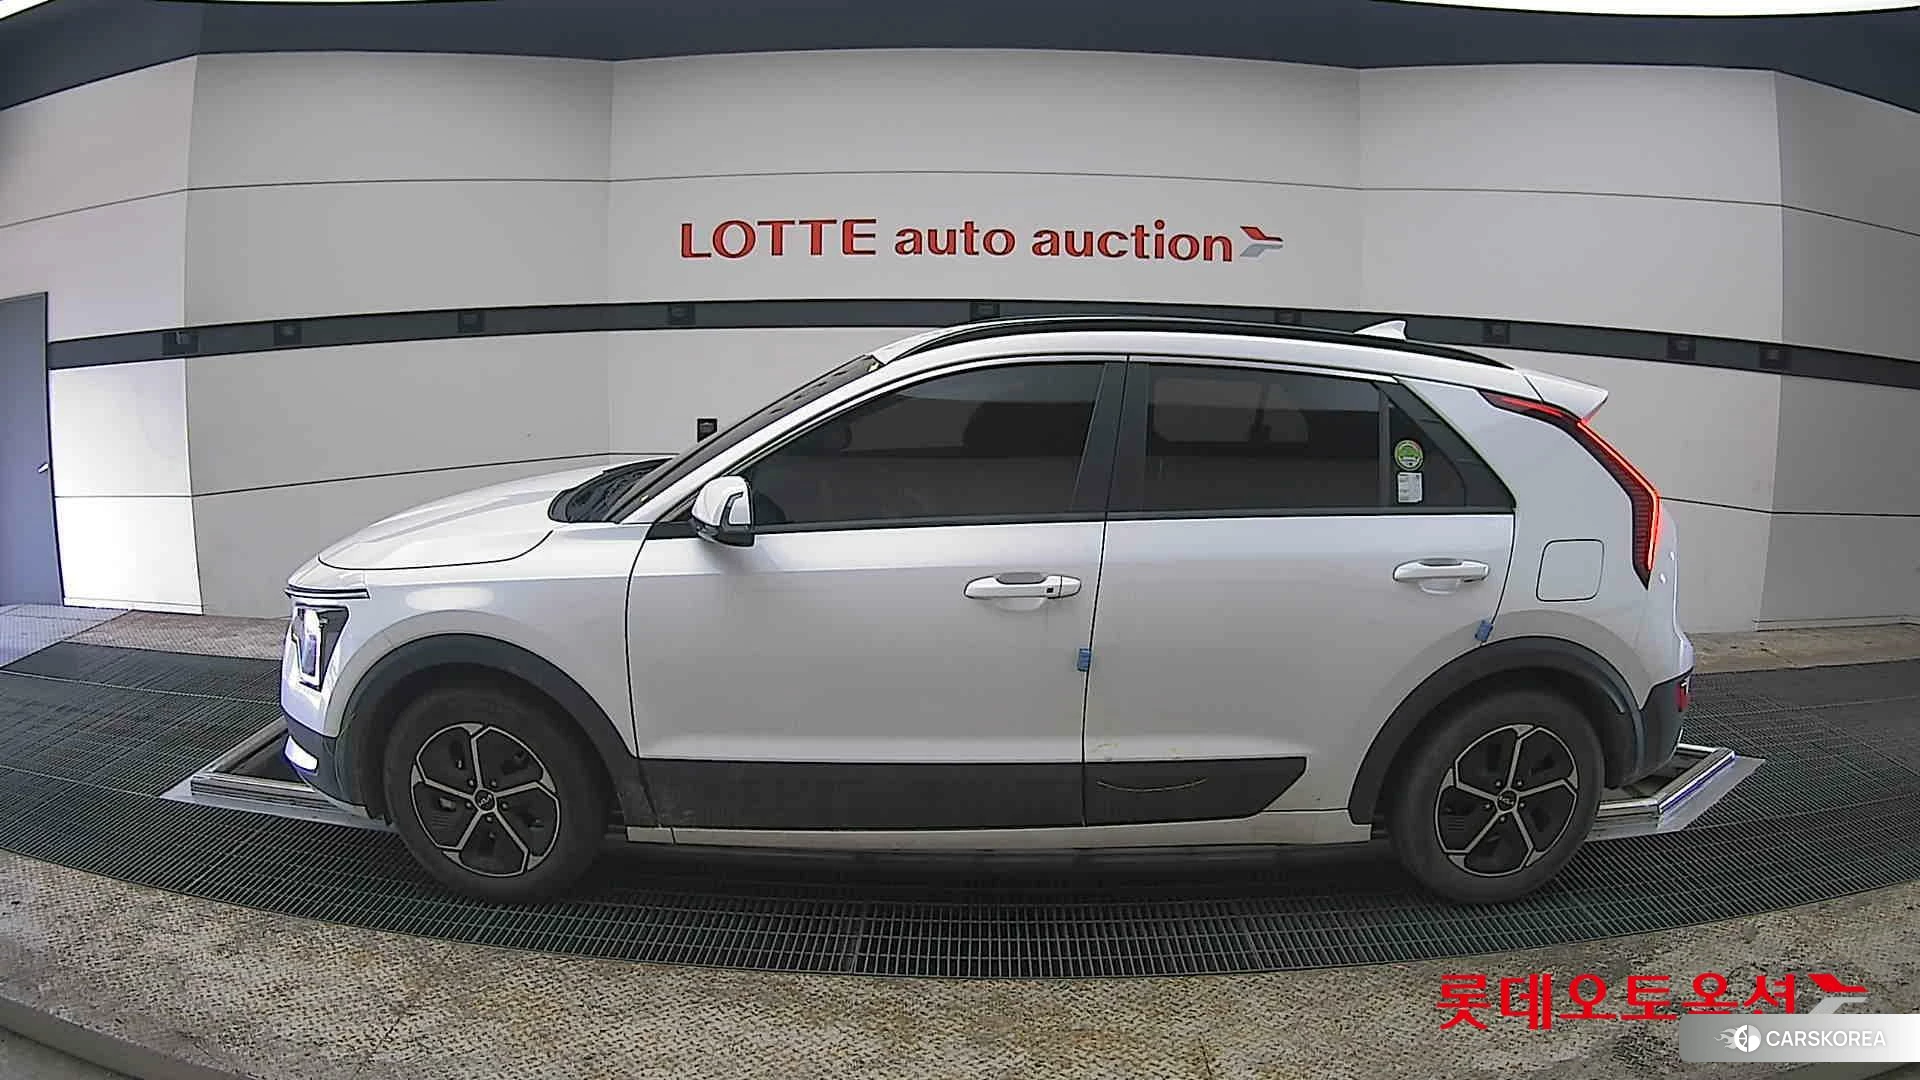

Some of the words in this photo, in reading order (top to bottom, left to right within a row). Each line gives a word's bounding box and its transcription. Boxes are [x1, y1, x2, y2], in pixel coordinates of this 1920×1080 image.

[680, 218, 877, 259] LOTTE
[894, 220, 1016, 256] auto
[1031, 219, 1233, 262] auction
